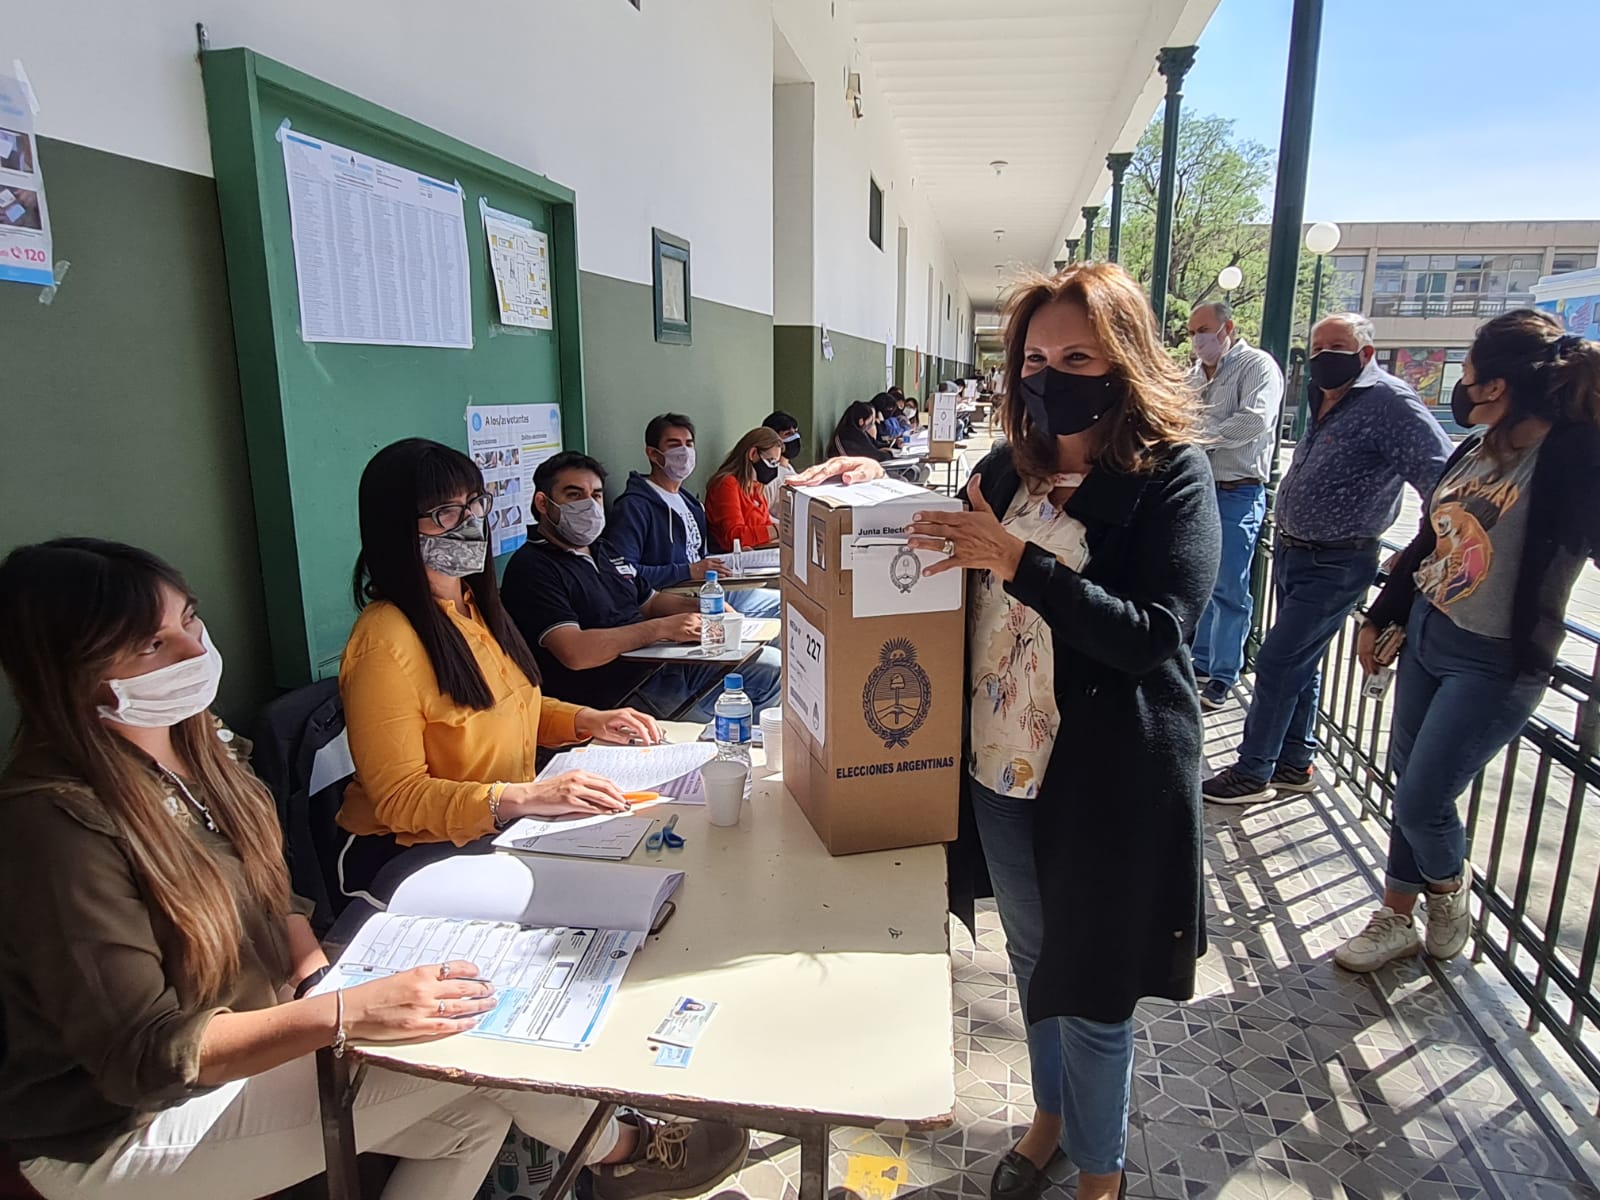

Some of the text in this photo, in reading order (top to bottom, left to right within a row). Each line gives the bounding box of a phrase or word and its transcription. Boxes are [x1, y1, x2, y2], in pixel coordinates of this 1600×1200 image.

[24, 248, 46, 262] 120
[857, 528, 881, 536] Junta
[806, 633, 821, 664] 227
[836, 756, 954, 779] ELECCIONES ARGENTINAS
